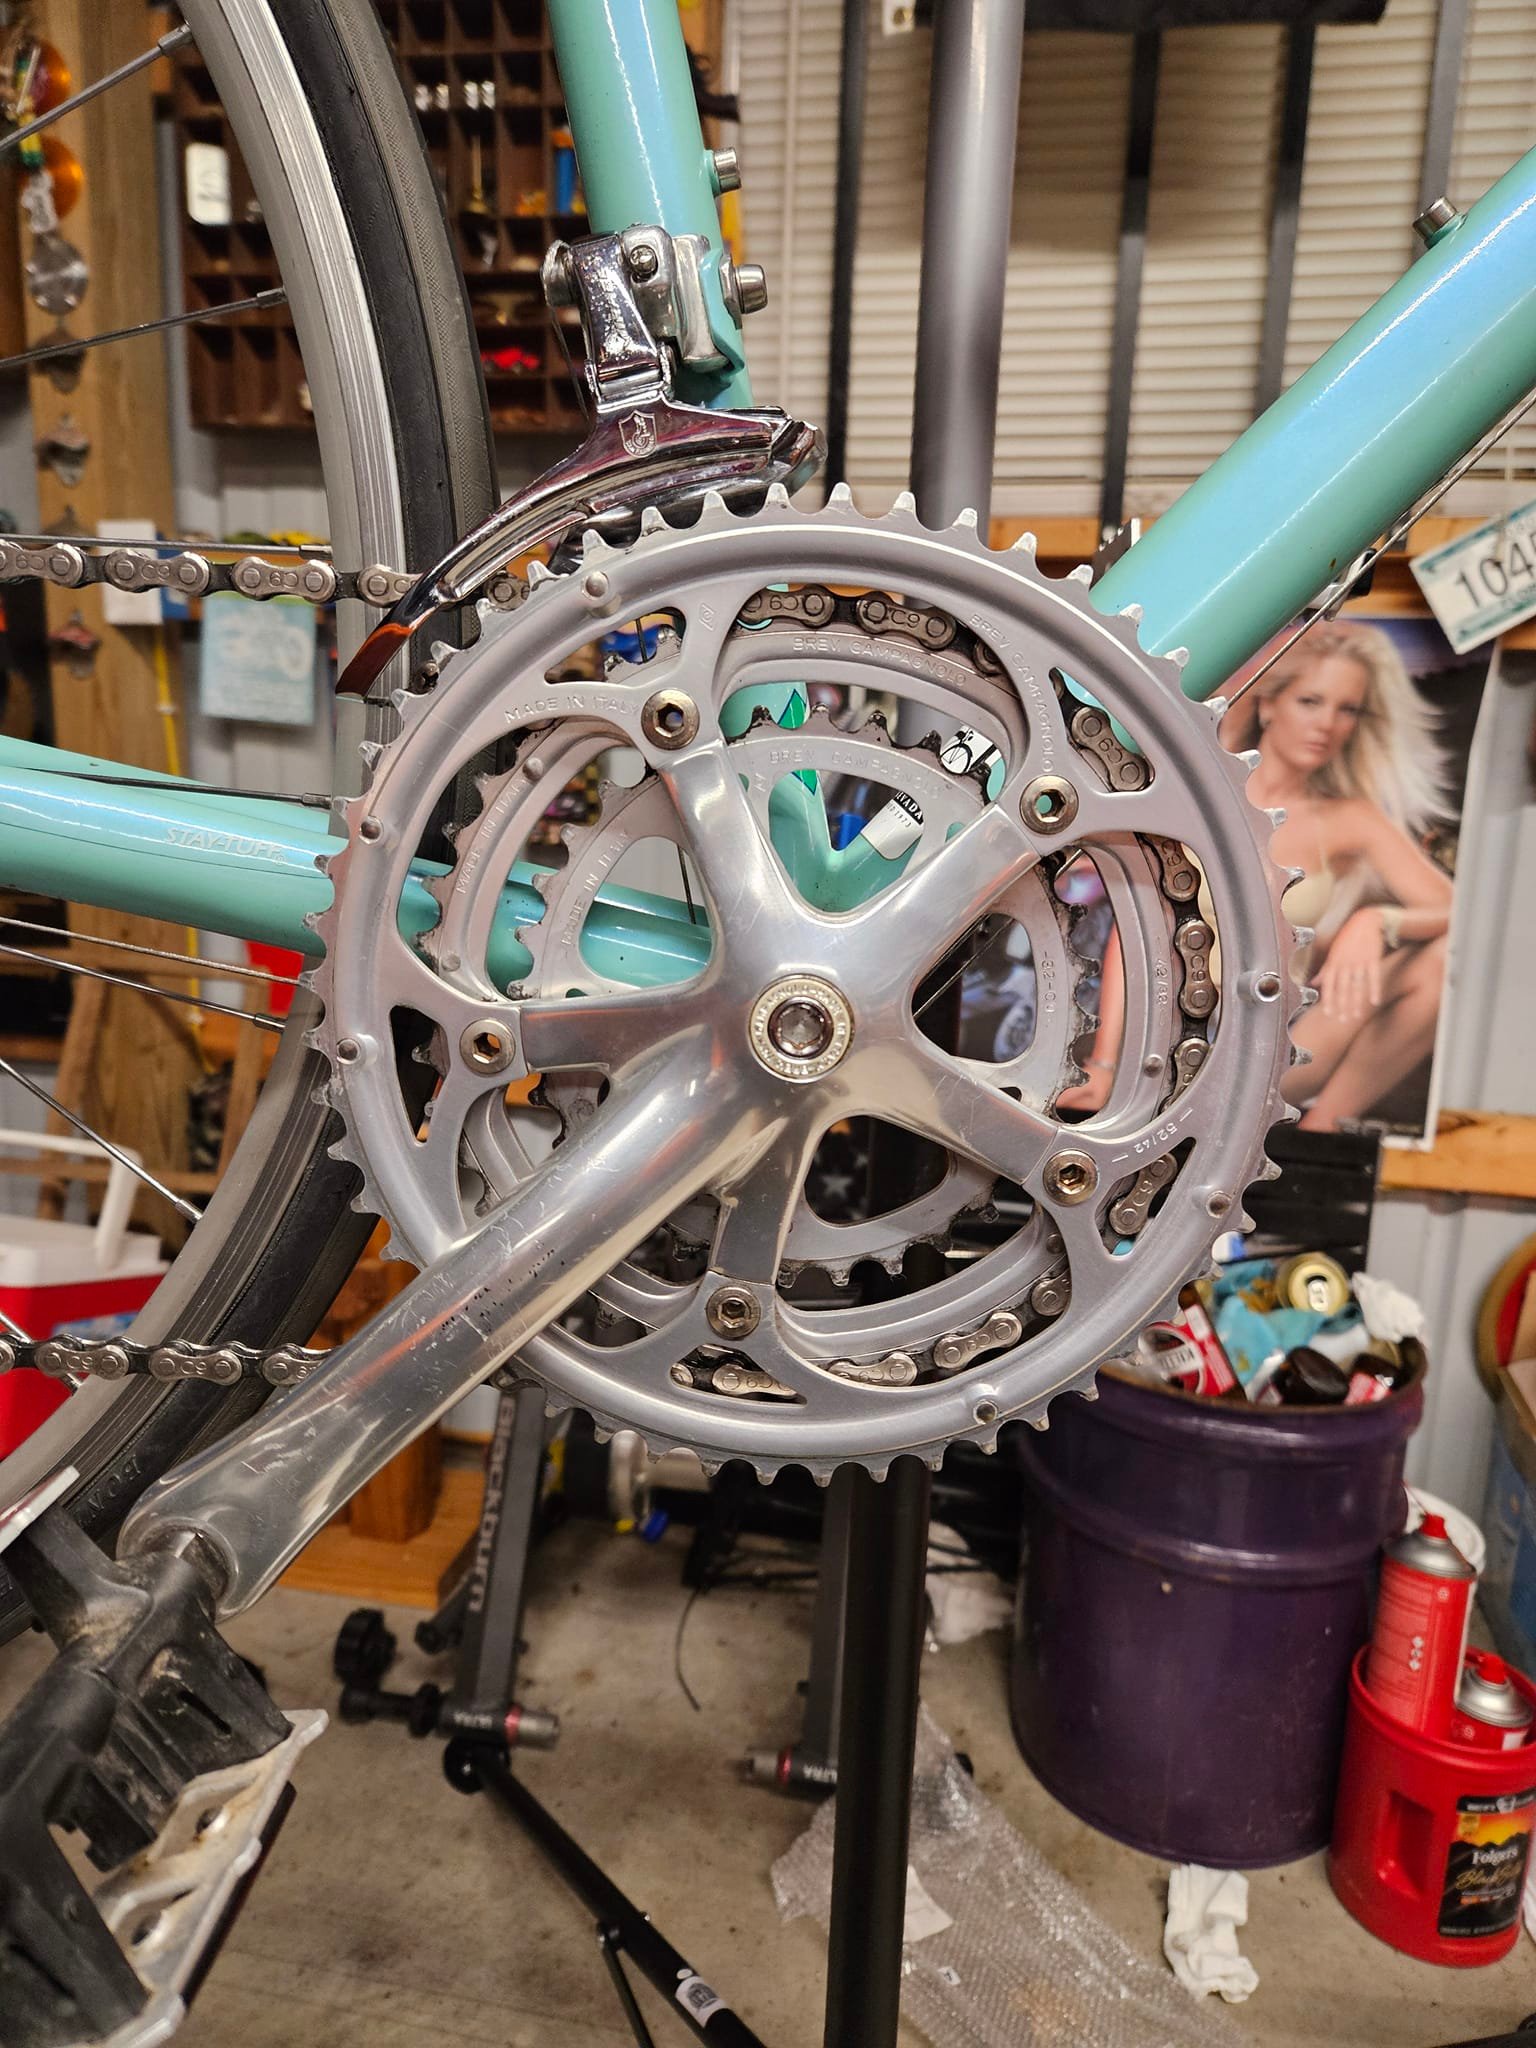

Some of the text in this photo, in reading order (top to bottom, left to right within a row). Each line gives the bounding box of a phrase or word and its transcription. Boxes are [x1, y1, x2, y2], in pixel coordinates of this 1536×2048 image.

[850, 641, 967, 687] CAMPAGNOLO
[504, 696, 641, 724] MADE IN ITALY
[481, 819, 497, 840] IN
[583, 873, 599, 892] IN
[469, 1397, 516, 1612] Blackburn
